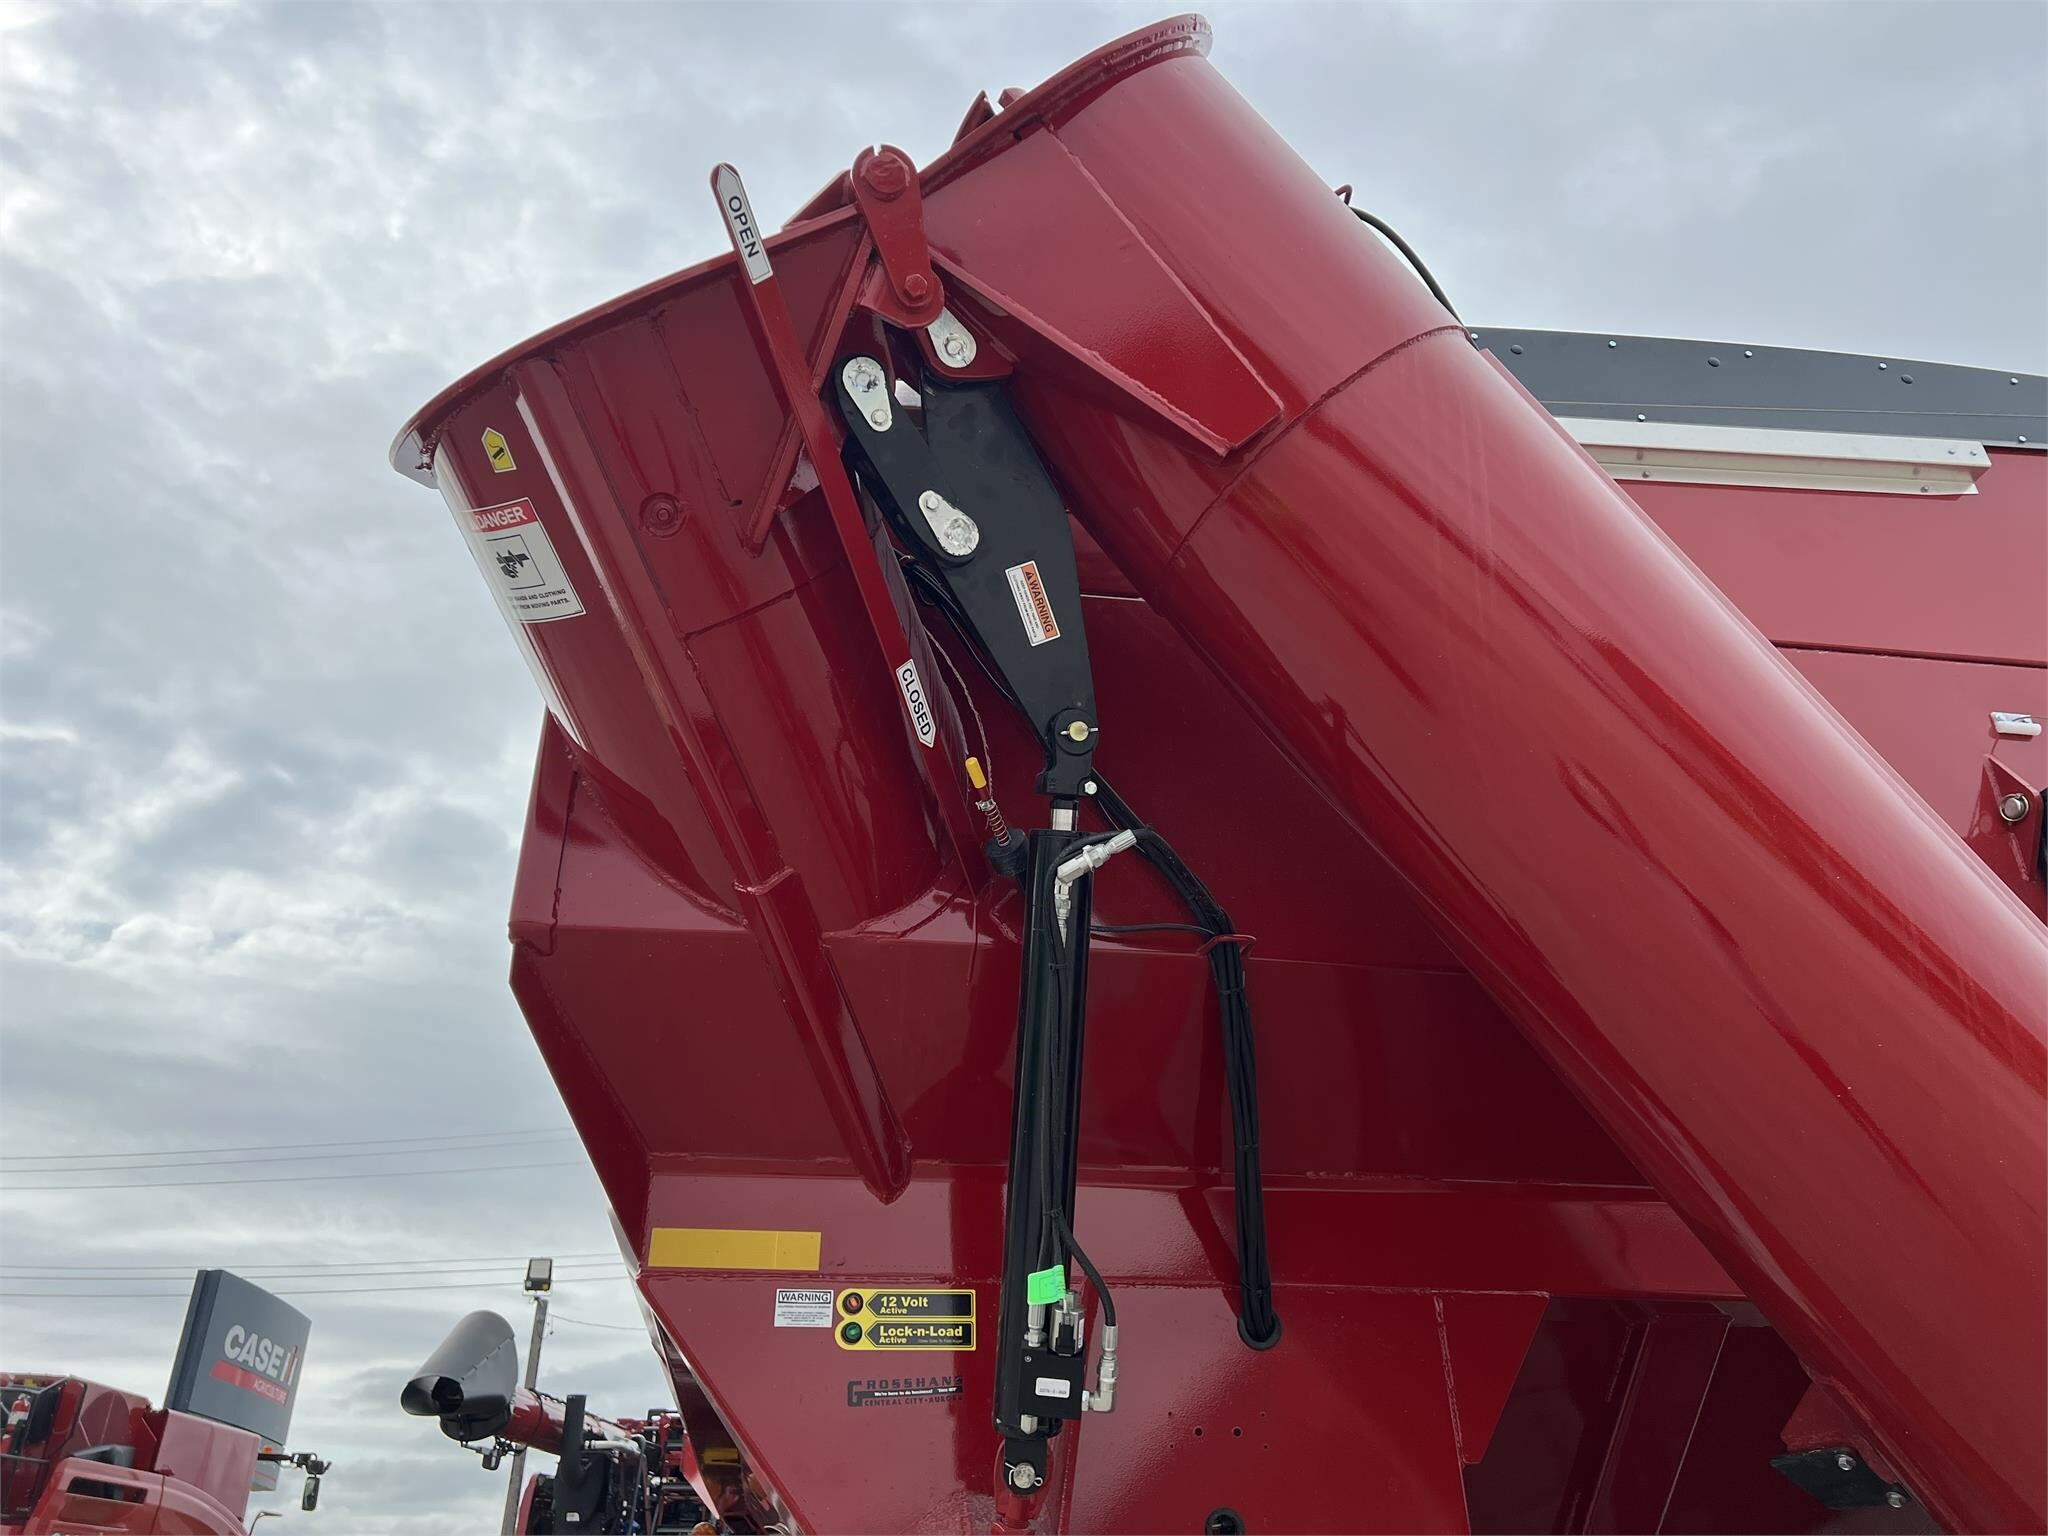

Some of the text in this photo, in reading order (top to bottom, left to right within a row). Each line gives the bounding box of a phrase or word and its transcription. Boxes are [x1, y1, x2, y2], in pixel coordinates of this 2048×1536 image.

[728, 195, 760, 258] OPEN
[475, 506, 528, 529] DANGER
[538, 588, 566, 599] CLOTHING
[1029, 579, 1054, 632] WARNING
[902, 668, 932, 736] CLOSED
[781, 1292, 829, 1302] WARNING
[881, 1296, 929, 1307] 12 Volt
[879, 1325, 963, 1337] Lock-n-Load
[879, 1336, 907, 1344] Active
[224, 1324, 285, 1378] CASE
[864, 1398, 901, 1407] CENTRAL
[905, 1397, 923, 1405] CITY
